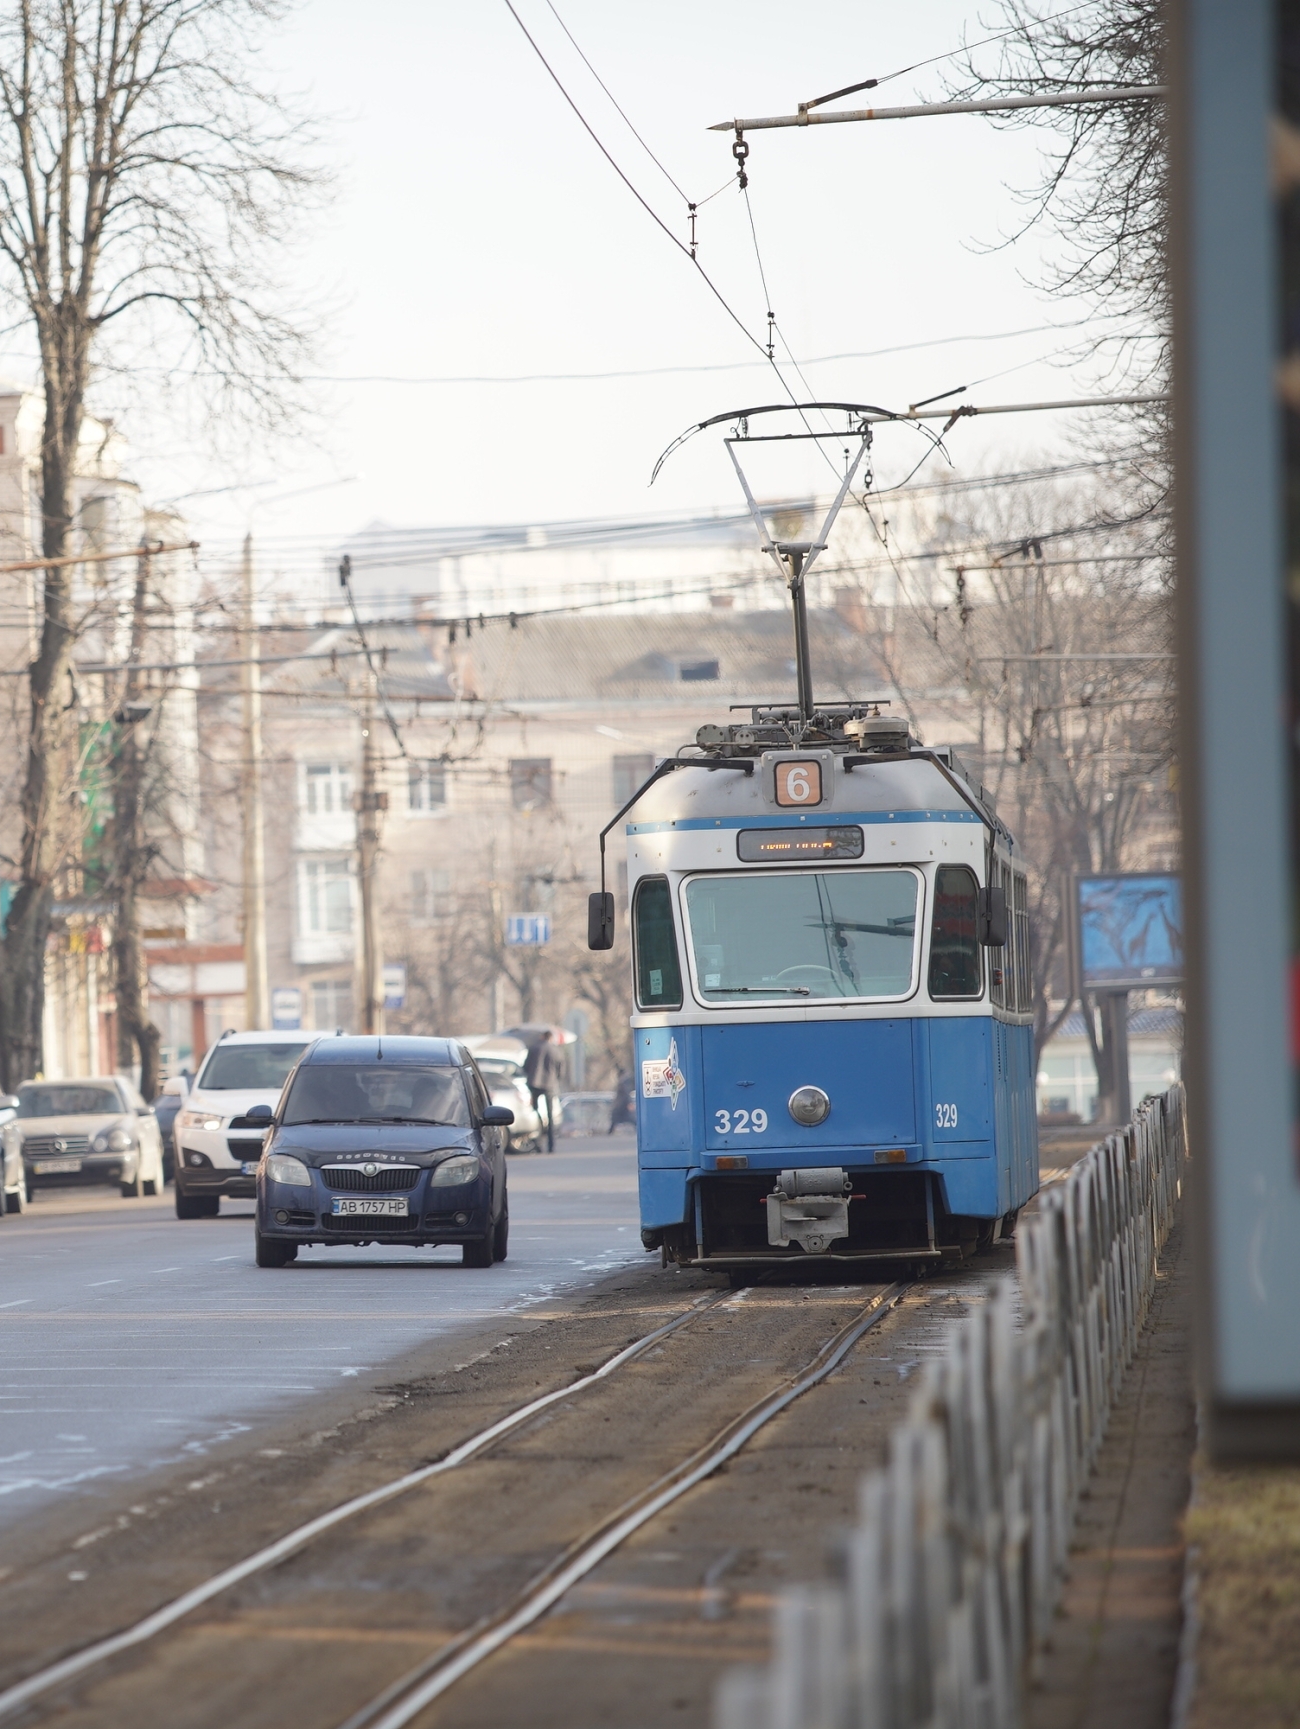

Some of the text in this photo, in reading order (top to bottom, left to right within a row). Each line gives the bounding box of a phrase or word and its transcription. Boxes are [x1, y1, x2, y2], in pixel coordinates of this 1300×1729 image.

[786, 767, 810, 802] 6
[714, 1108, 768, 1134] 329
[935, 1103, 958, 1128] 329
[340, 1201, 357, 1213] AB
[359, 1201, 386, 1213] 1757
[388, 1202, 406, 1213] HP
